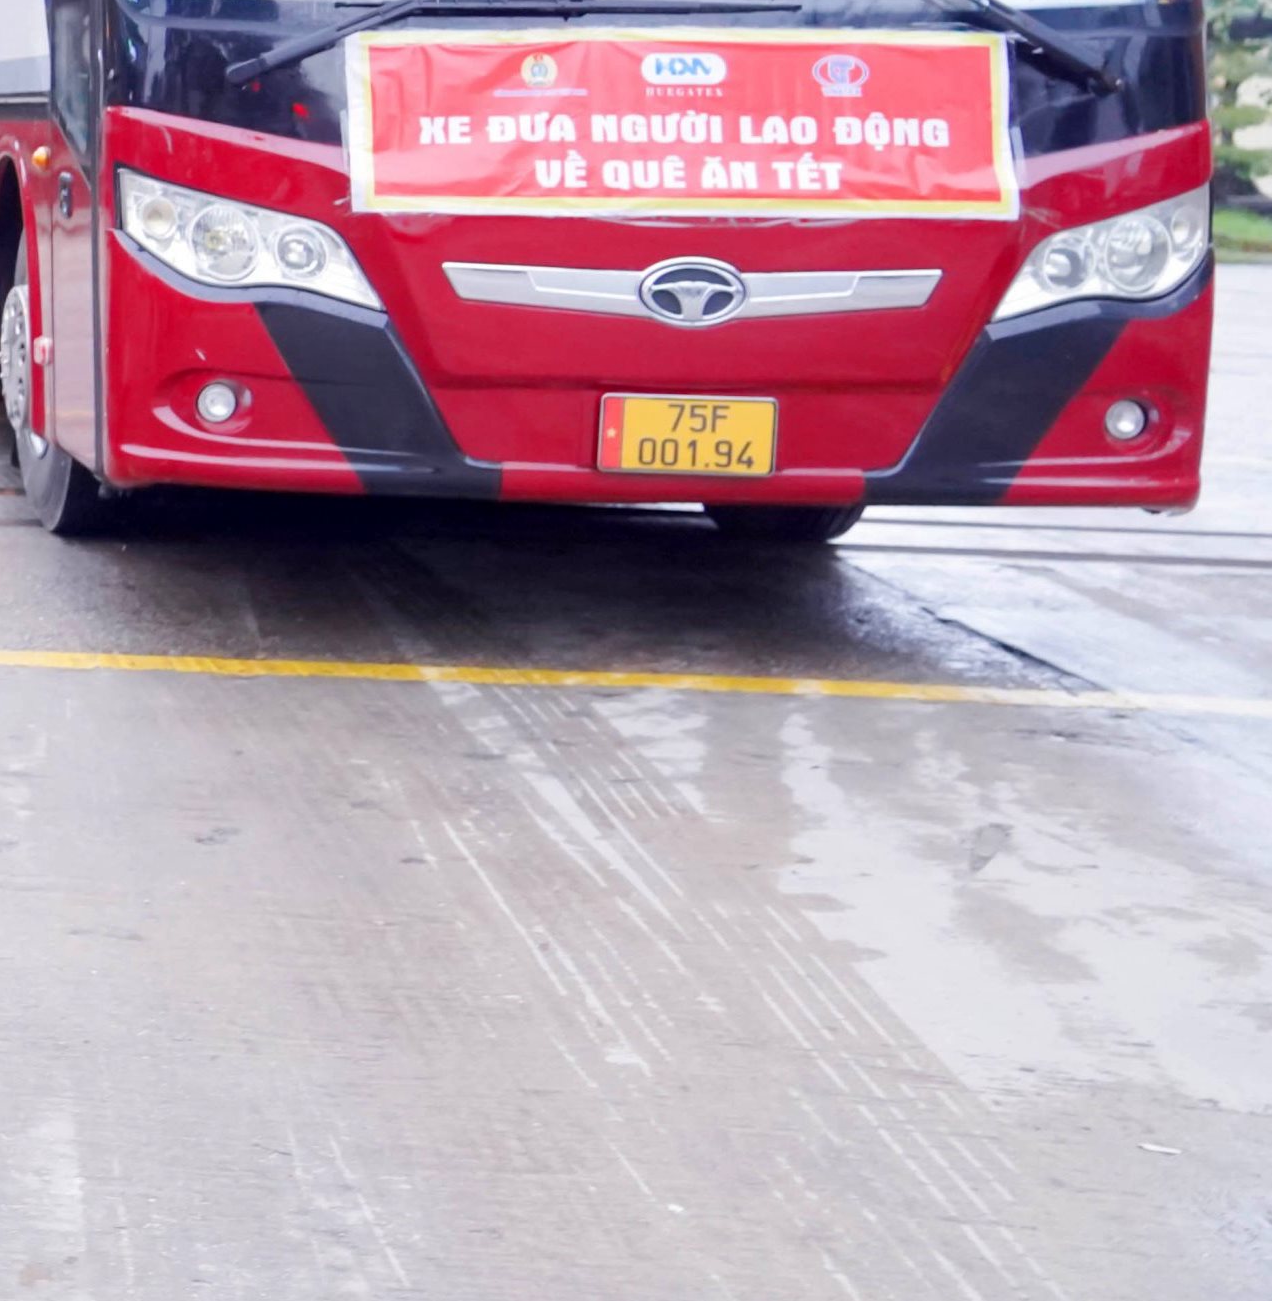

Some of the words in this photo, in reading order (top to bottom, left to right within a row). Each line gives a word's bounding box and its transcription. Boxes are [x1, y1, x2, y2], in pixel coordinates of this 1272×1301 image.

[419, 116, 472, 144] XE
[486, 112, 576, 142] ĐƯA
[591, 110, 723, 143] NGƯỜI
[739, 116, 817, 144] LAO
[832, 112, 949, 151] ĐỘNG
[535, 150, 587, 188] VỀ
[602, 155, 686, 190] QUÊ
[701, 156, 758, 189] ĂN
[771, 152, 842, 190] TẾT
[668, 404, 730, 433] 75F
[639, 438, 754, 468] 001.94
